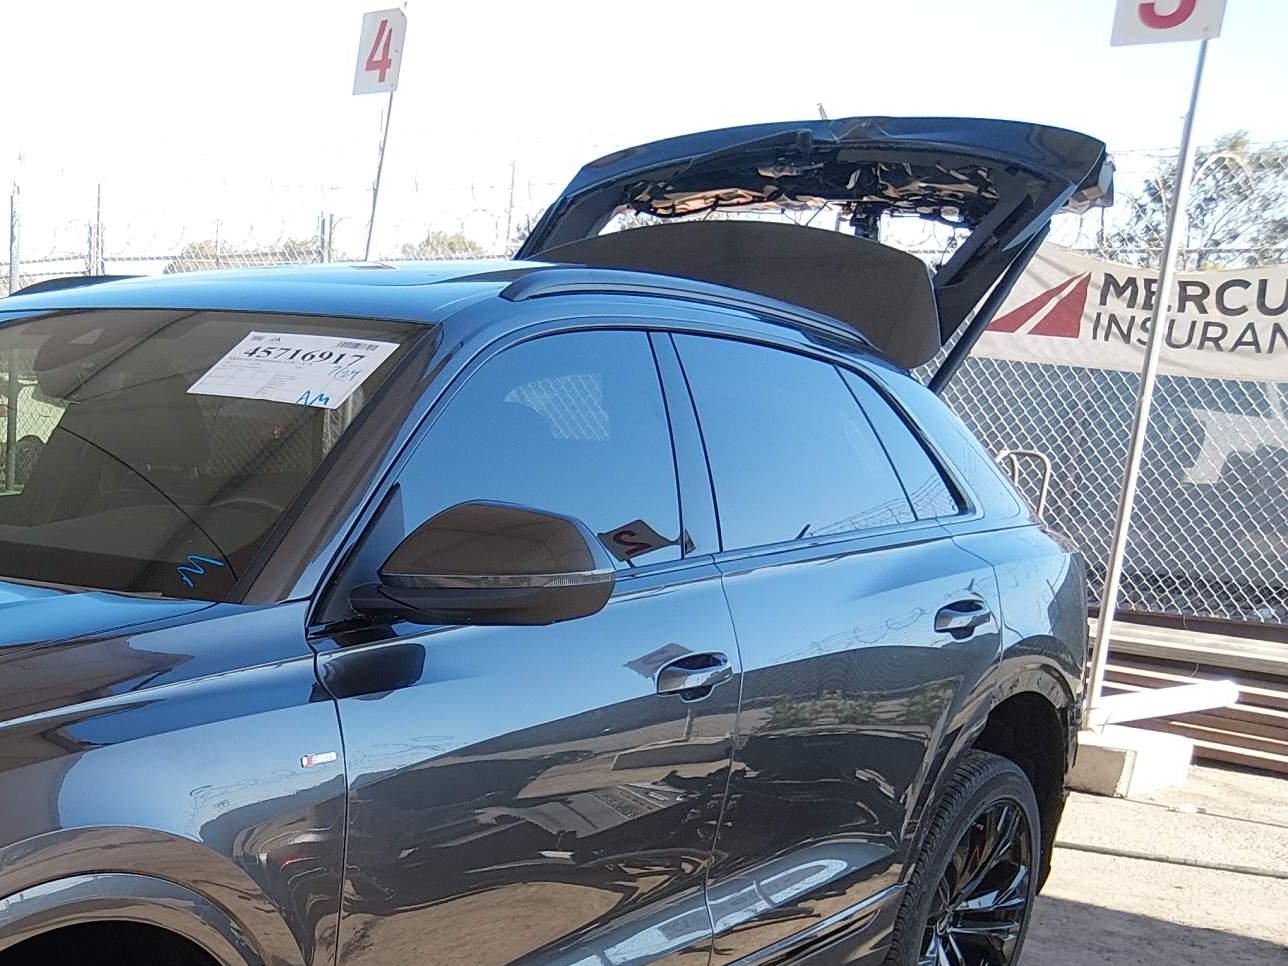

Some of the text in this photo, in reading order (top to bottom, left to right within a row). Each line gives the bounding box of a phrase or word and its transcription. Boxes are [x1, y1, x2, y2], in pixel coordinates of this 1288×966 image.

[365, 19, 393, 83] 4
[1099, 271, 1288, 317] MERCU
[243, 346, 367, 367] 45716917
